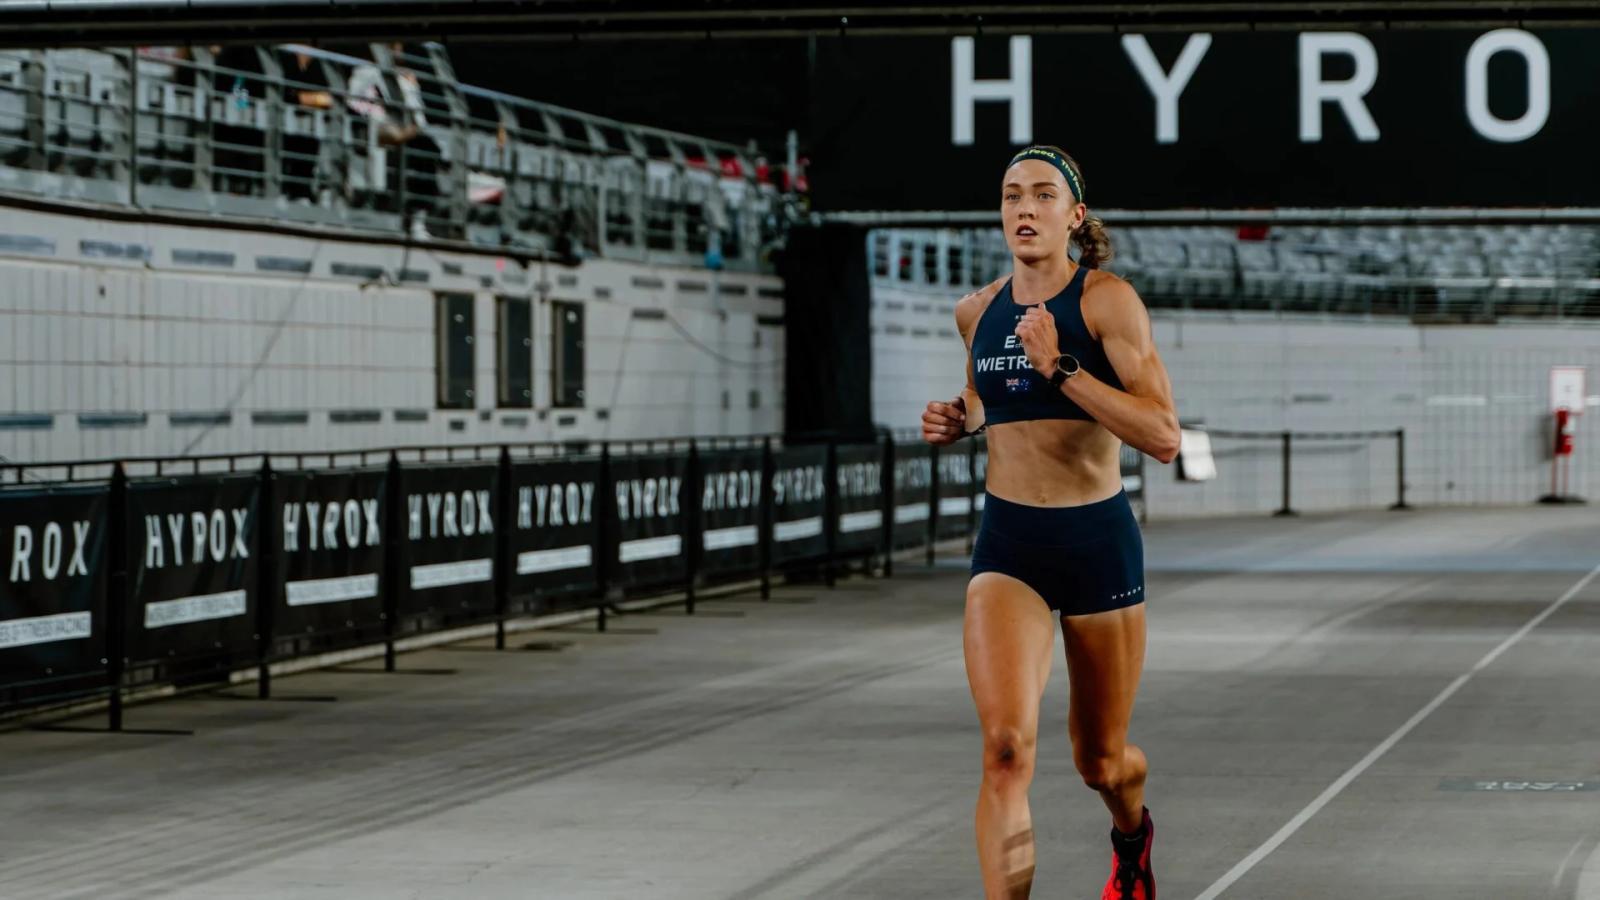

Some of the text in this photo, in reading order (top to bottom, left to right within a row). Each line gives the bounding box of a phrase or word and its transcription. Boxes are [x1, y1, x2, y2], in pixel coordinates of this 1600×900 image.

[951, 28, 1551, 145] HYRO
[283, 498, 380, 552] HYROX
[407, 489, 494, 540] HYROX
[517, 482, 595, 530] HYROX
[10, 520, 90, 582] ROX
